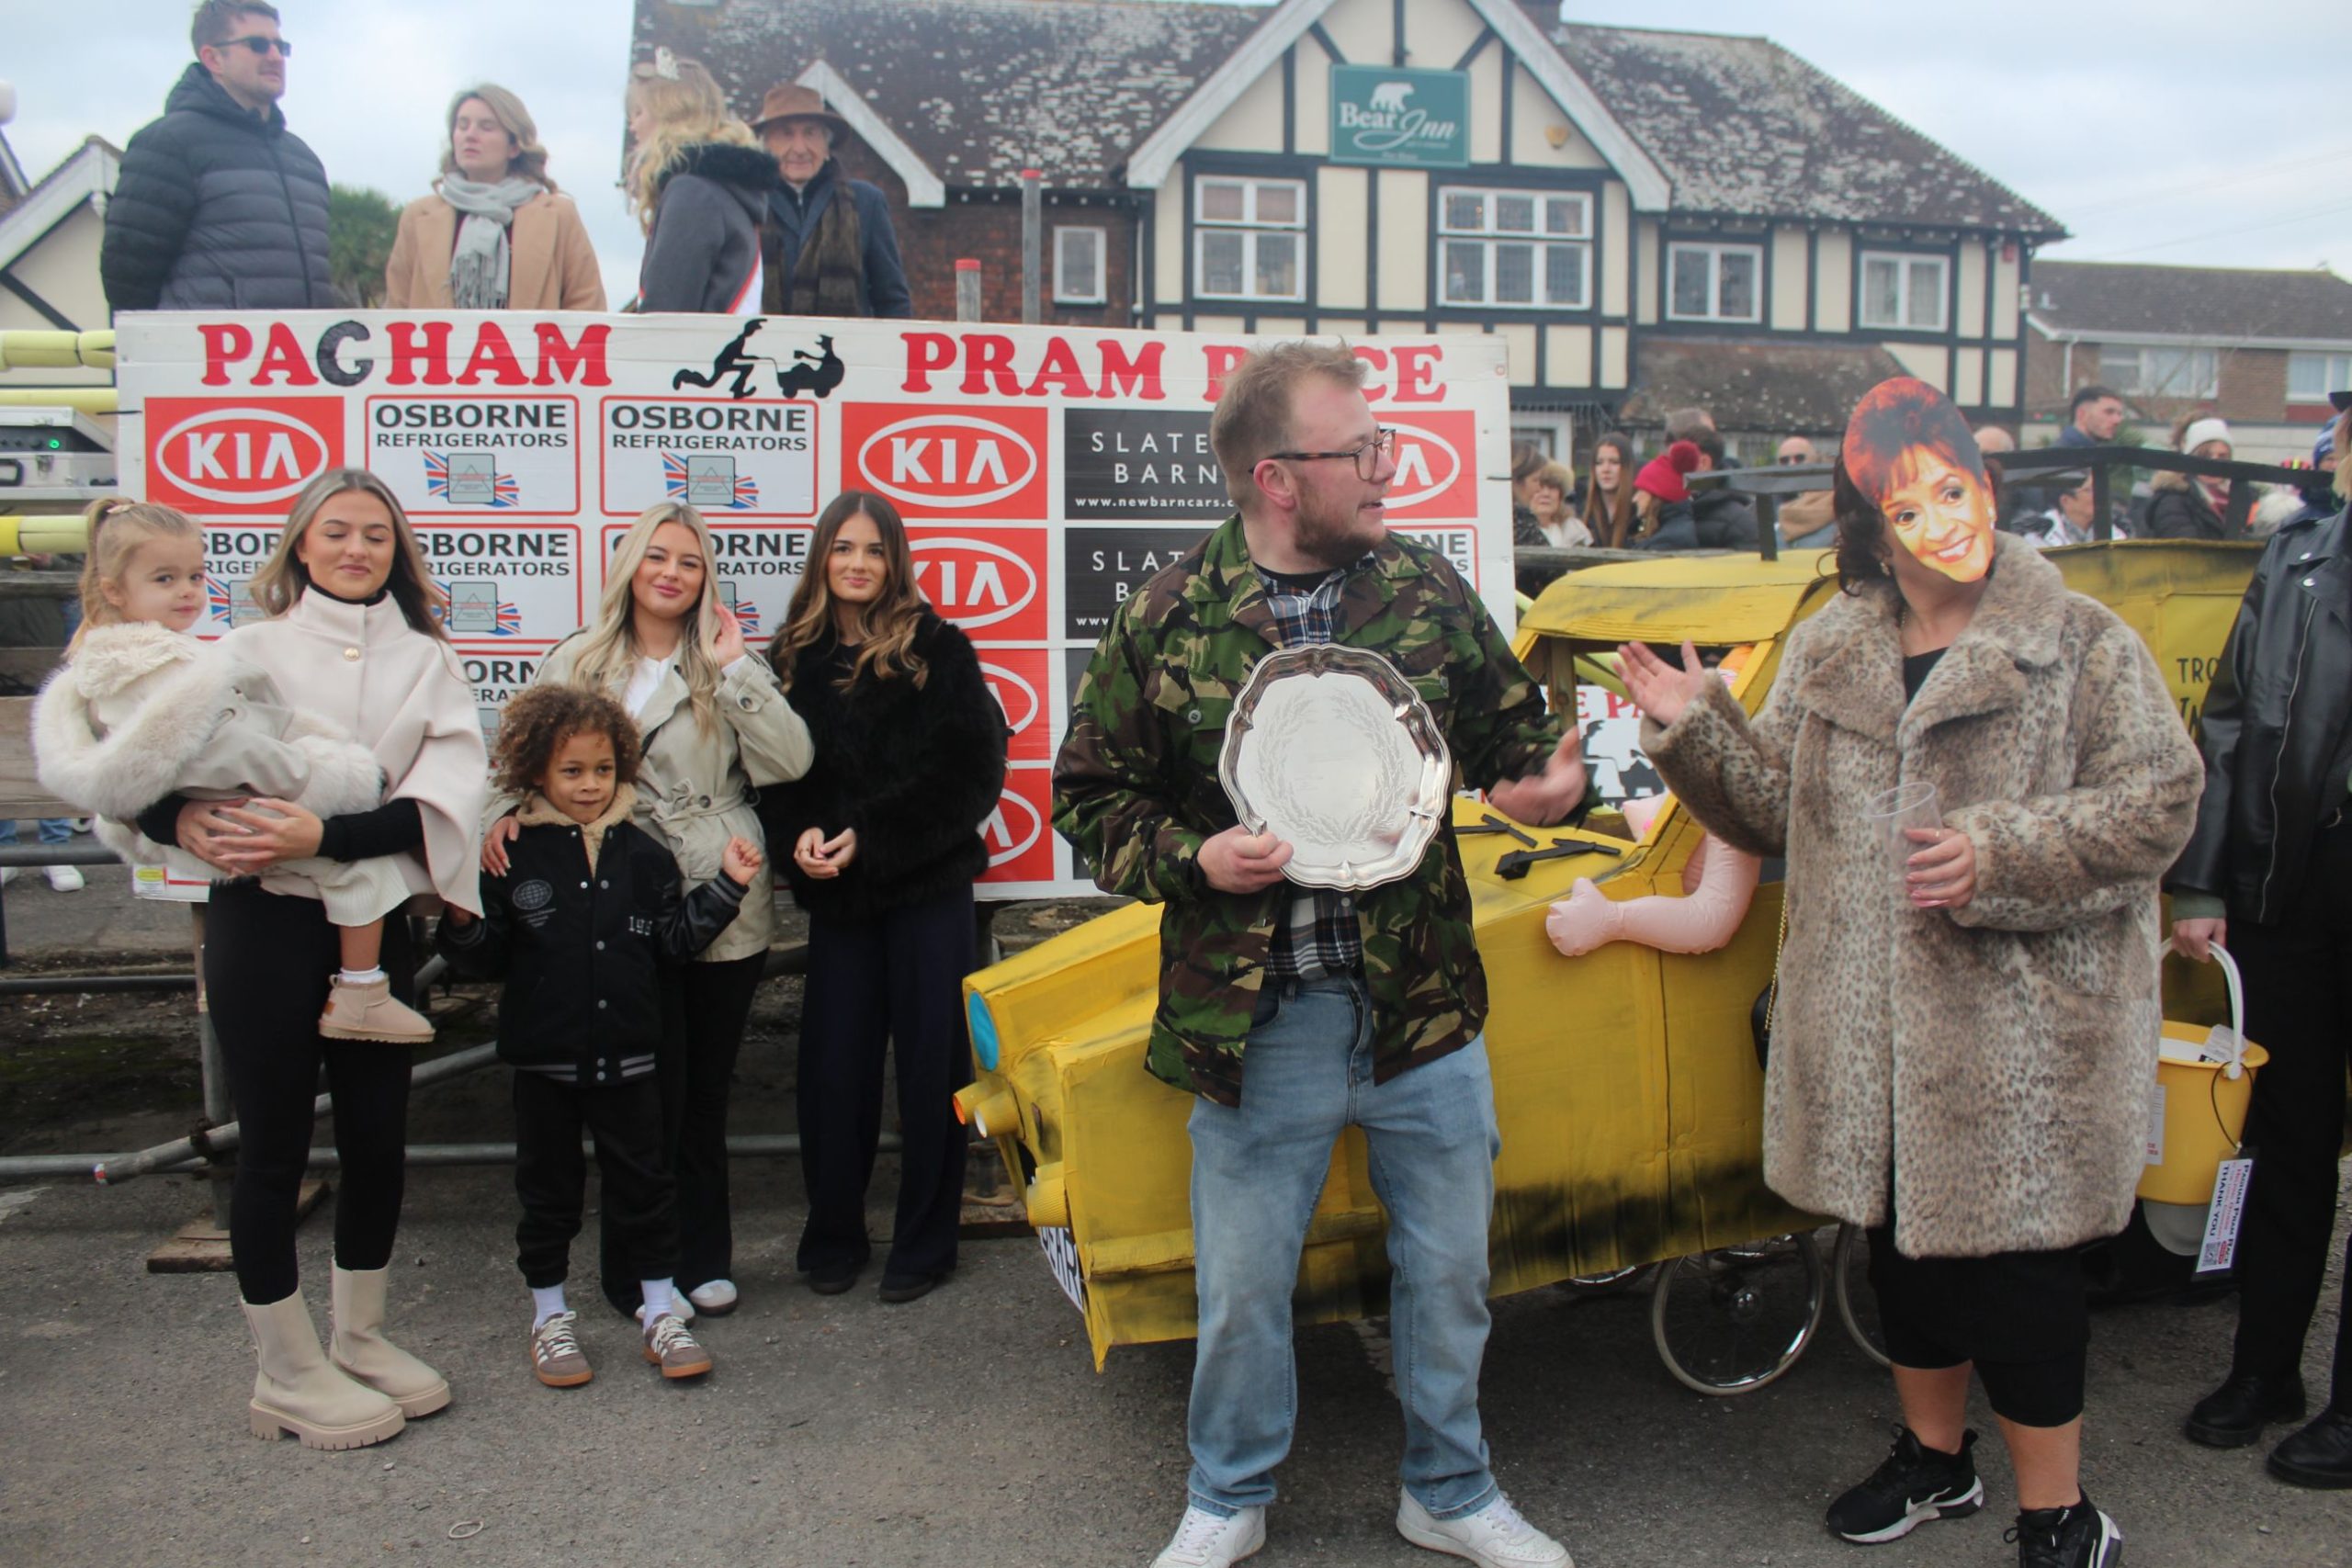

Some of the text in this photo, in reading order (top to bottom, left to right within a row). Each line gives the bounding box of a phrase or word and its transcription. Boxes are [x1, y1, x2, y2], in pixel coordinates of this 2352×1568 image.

[1340, 102, 1397, 129] Bear
[198, 321, 1447, 402] PAGHAM PRAM RCE
[375, 404, 566, 428] OSBORNE
[612, 405, 806, 432] OSBORNE
[377, 434, 569, 447] REFRIGERATORS
[613, 434, 807, 451] REFRIGERATORS
[1091, 432, 1208, 454] SLATE
[187, 432, 301, 479] KIA
[890, 437, 1010, 485] KIA
[1114, 463, 1217, 484] BARN
[1075, 496, 1234, 508] www.newbarncars.c
[414, 533, 568, 557] SBORNE
[424, 561, 570, 576] RIGERATORS
[2215, 1164, 2230, 1208] THANK
[2210, 1211, 2220, 1236] YOU
